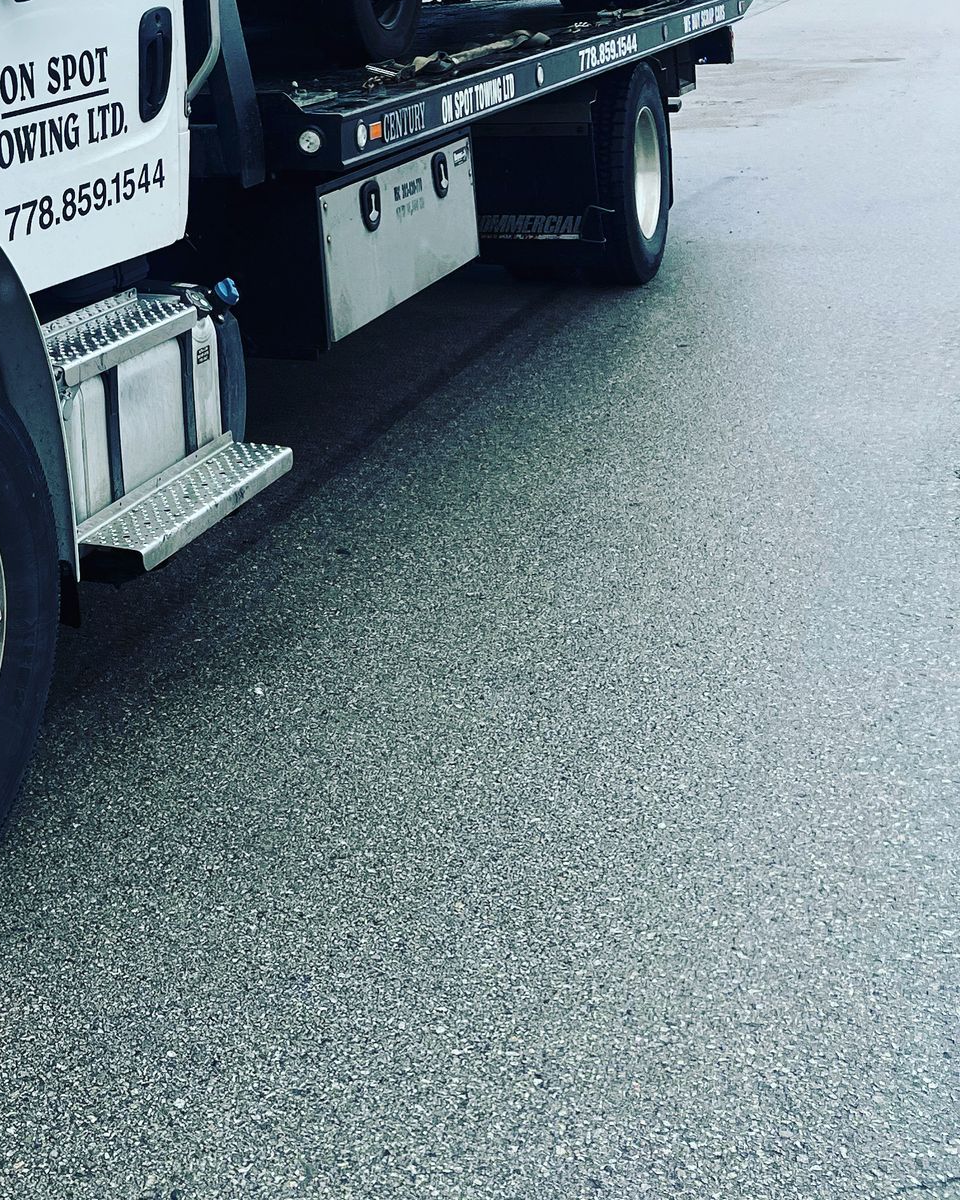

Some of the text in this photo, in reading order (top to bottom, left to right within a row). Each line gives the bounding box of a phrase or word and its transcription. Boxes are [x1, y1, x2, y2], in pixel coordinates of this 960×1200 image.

[578, 32, 638, 72] 778.859.1544
[0, 46, 108, 105] ON SPOT
[441, 73, 515, 124] ON SPOT TOWING LTD
[87, 101, 128, 144] LTD.
[383, 101, 426, 143] CENTURY
[4, 158, 165, 242] 778.859.1544
[479, 214, 582, 234] OMMERCIAL
